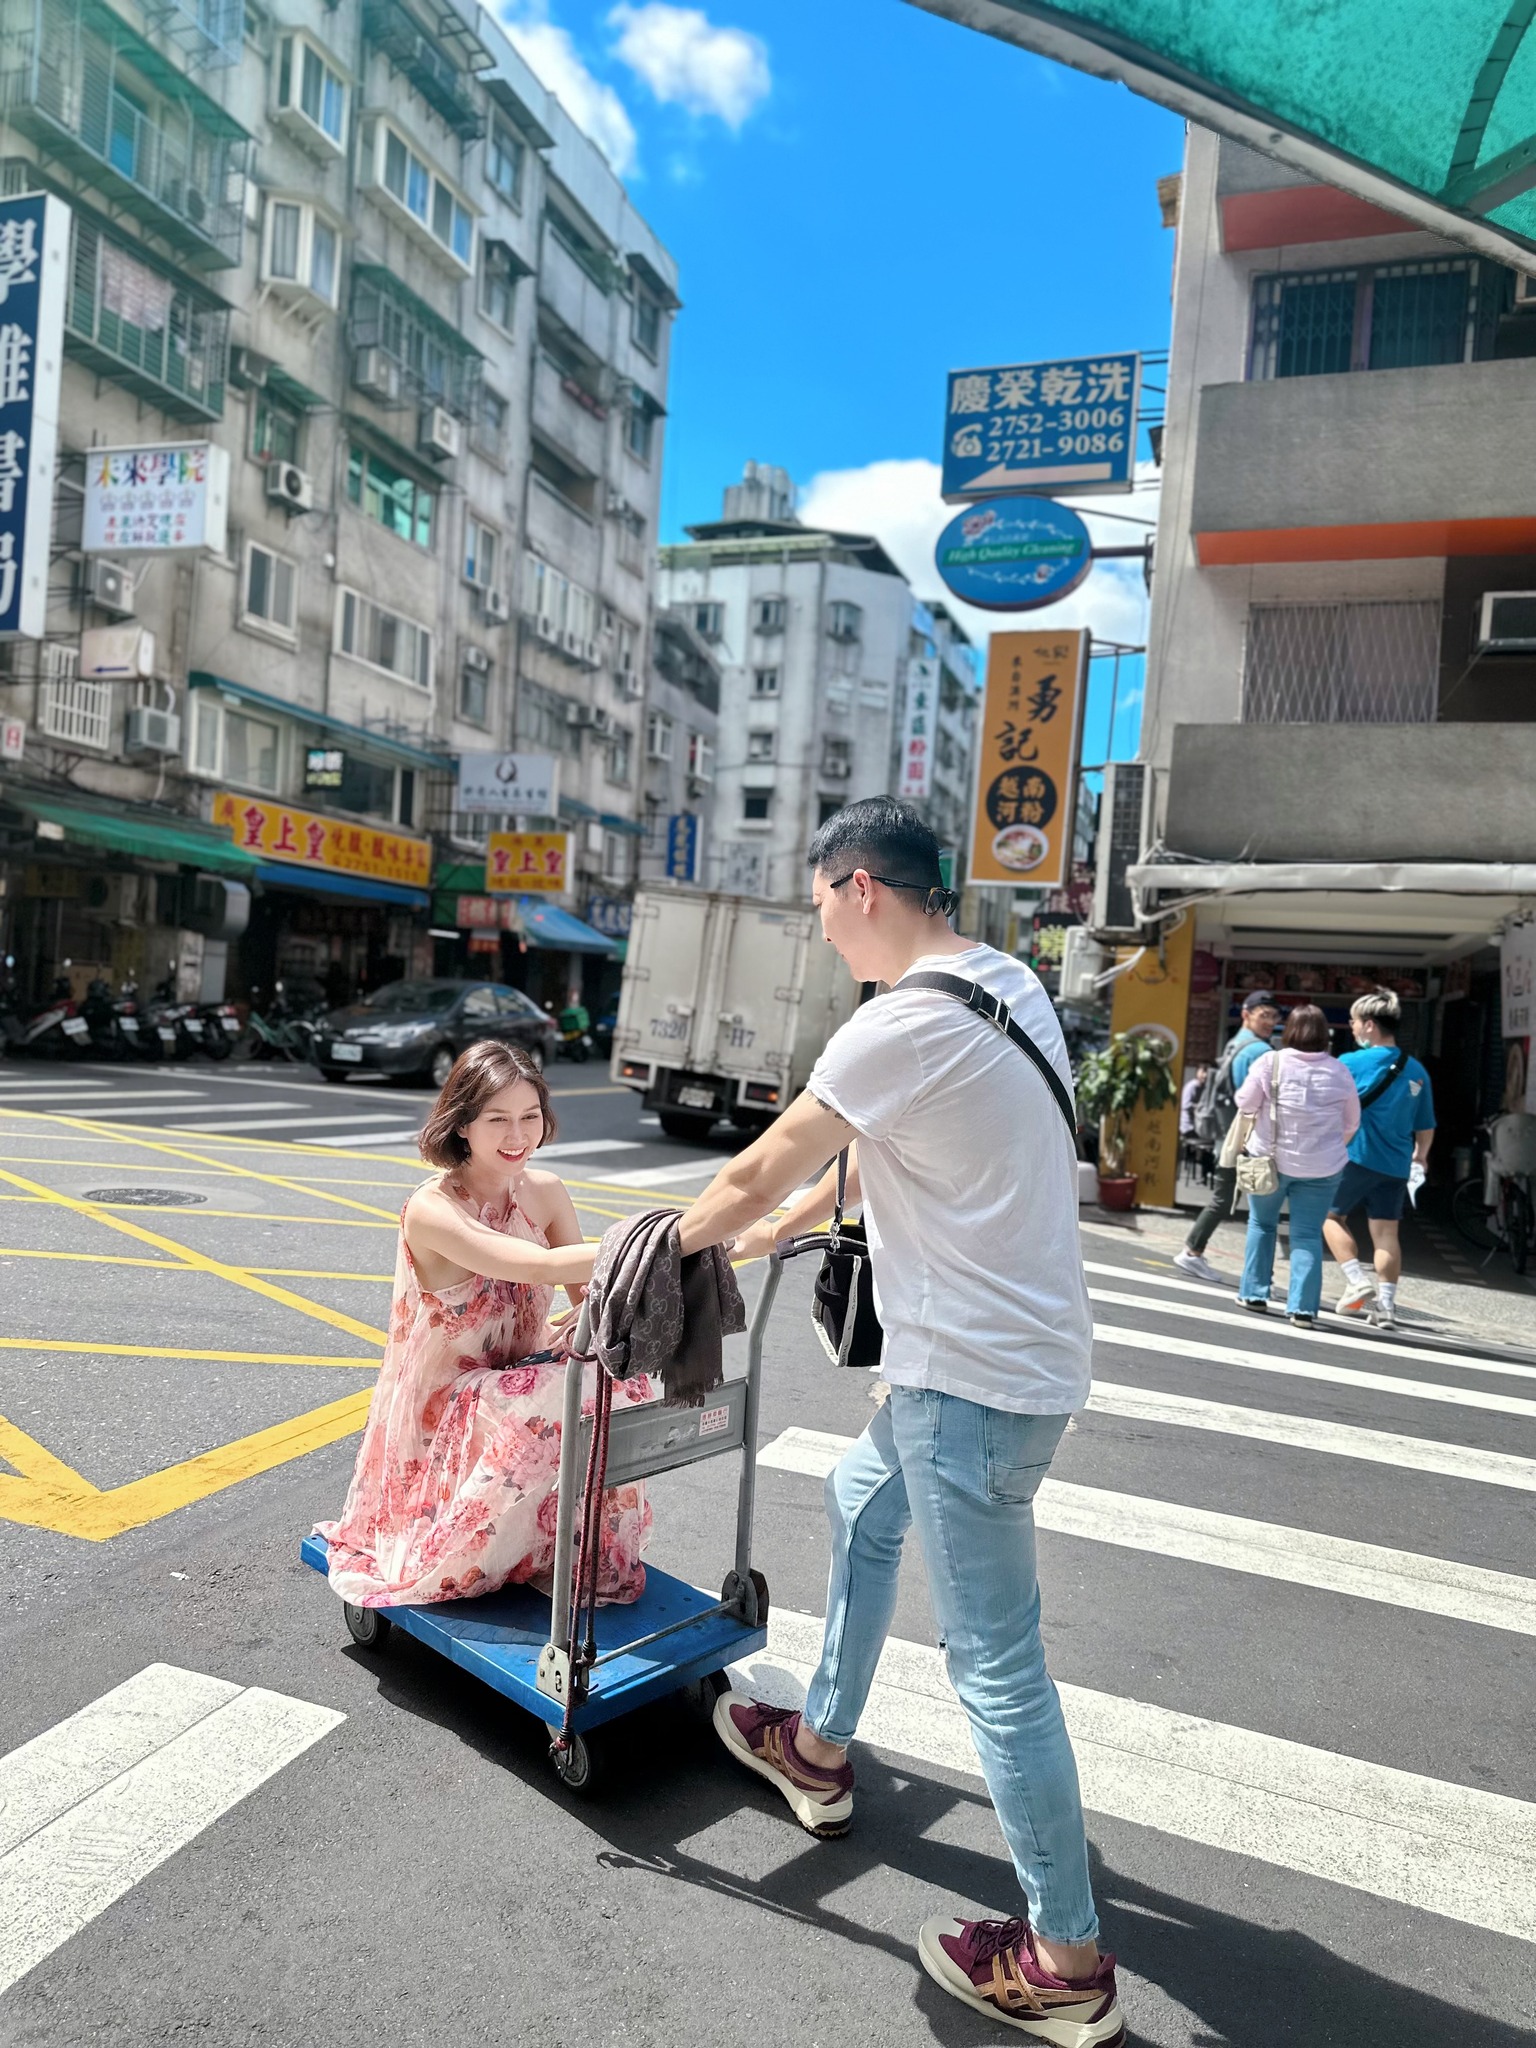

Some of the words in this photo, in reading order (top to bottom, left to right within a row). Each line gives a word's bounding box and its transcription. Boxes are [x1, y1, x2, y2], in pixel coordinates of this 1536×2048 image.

[951, 362, 1130, 414] 慶榮乾洗
[988, 407, 1125, 438] 2752-3006
[986, 432, 1125, 462] 2721-9086
[94, 449, 205, 488] 未來學院
[949, 548, 976, 562] High
[978, 545, 1020, 561] Quality
[1021, 543, 1075, 557] Cleaning
[994, 673, 1063, 762] 勇記
[997, 775, 1047, 800] 越南
[996, 800, 1045, 824] 河粉
[242, 804, 326, 862] 皇上皇
[493, 848, 563, 876] 皇上皇
[650, 1018, 689, 1041] 7320
